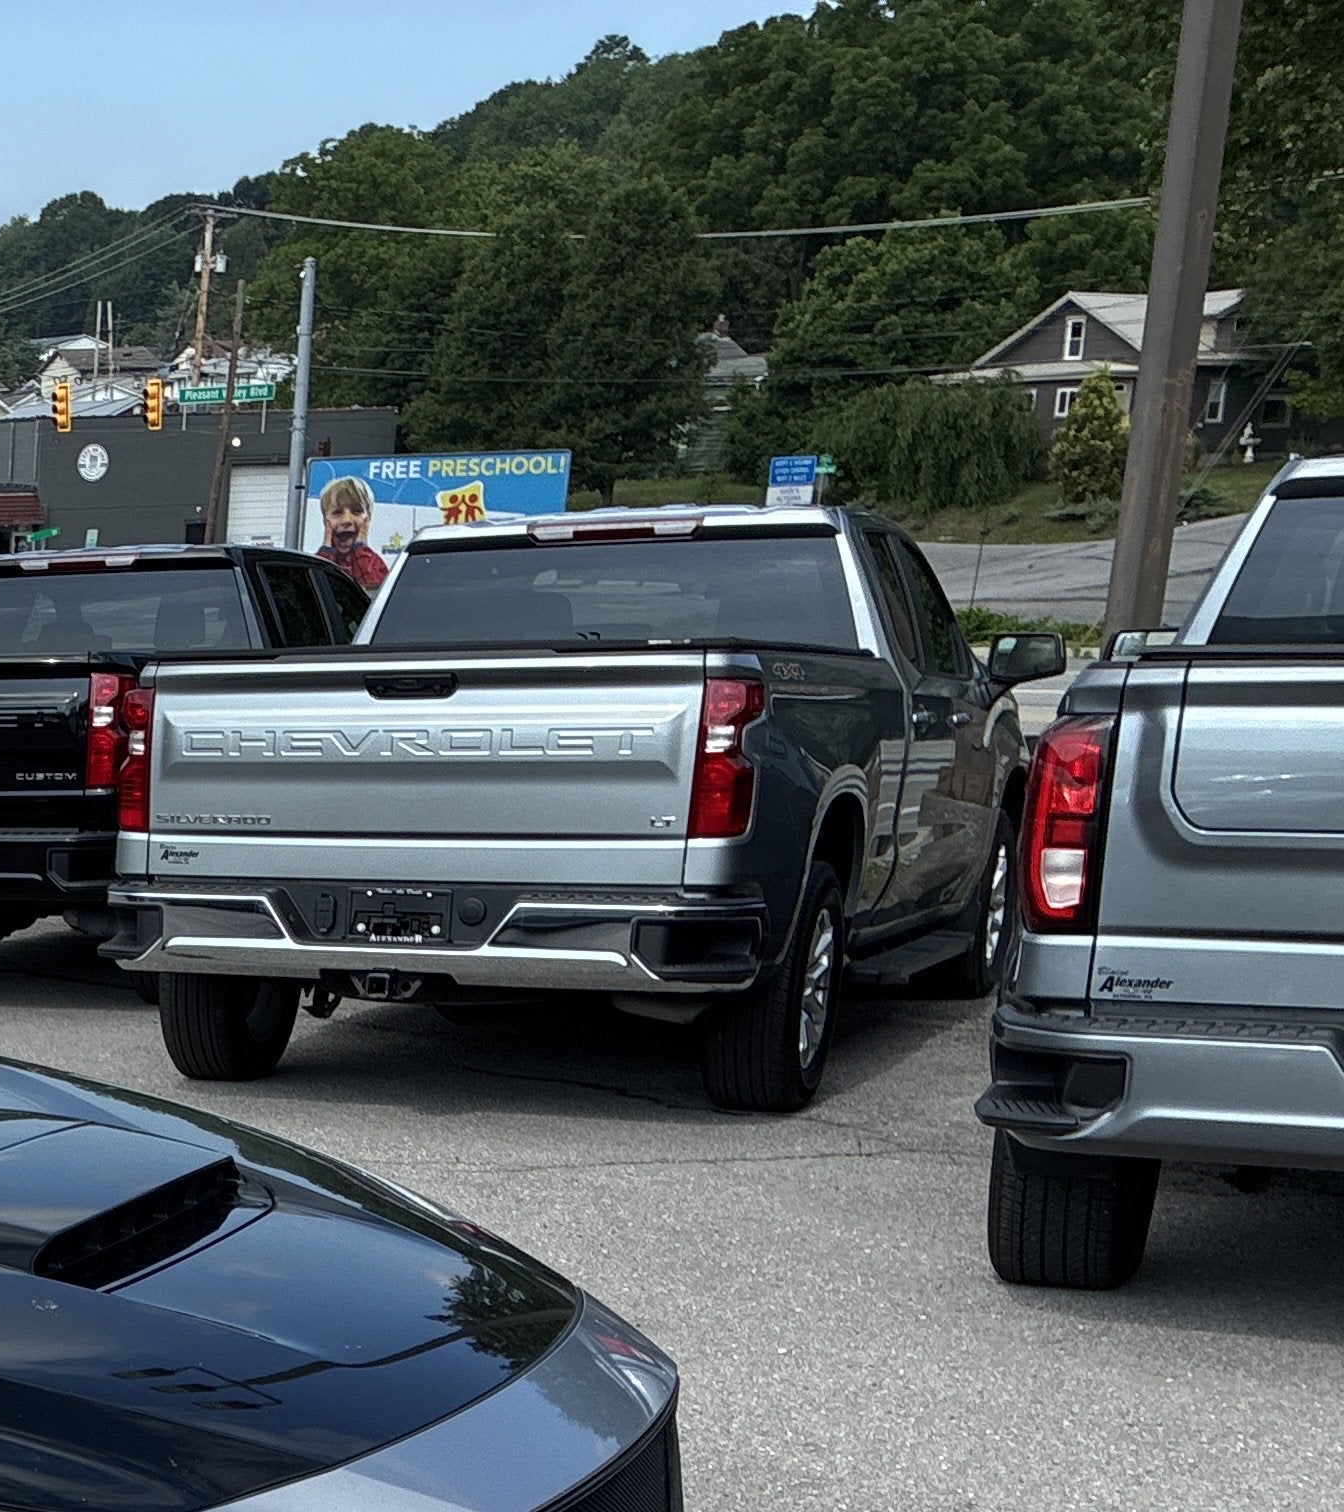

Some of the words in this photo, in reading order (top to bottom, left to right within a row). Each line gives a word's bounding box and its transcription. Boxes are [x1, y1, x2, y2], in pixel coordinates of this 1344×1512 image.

[185, 389, 220, 400] Pleasant
[250, 386, 269, 397] Blvd
[369, 460, 422, 480] FREE
[427, 455, 567, 478] PRESCHOOL!
[181, 727, 656, 757] CHEVROLET
[15, 772, 78, 781] CUSTOM
[156, 814, 272, 825] SILVERADO
[650, 815, 676, 828] LT
[1098, 976, 1174, 992] Alexander
